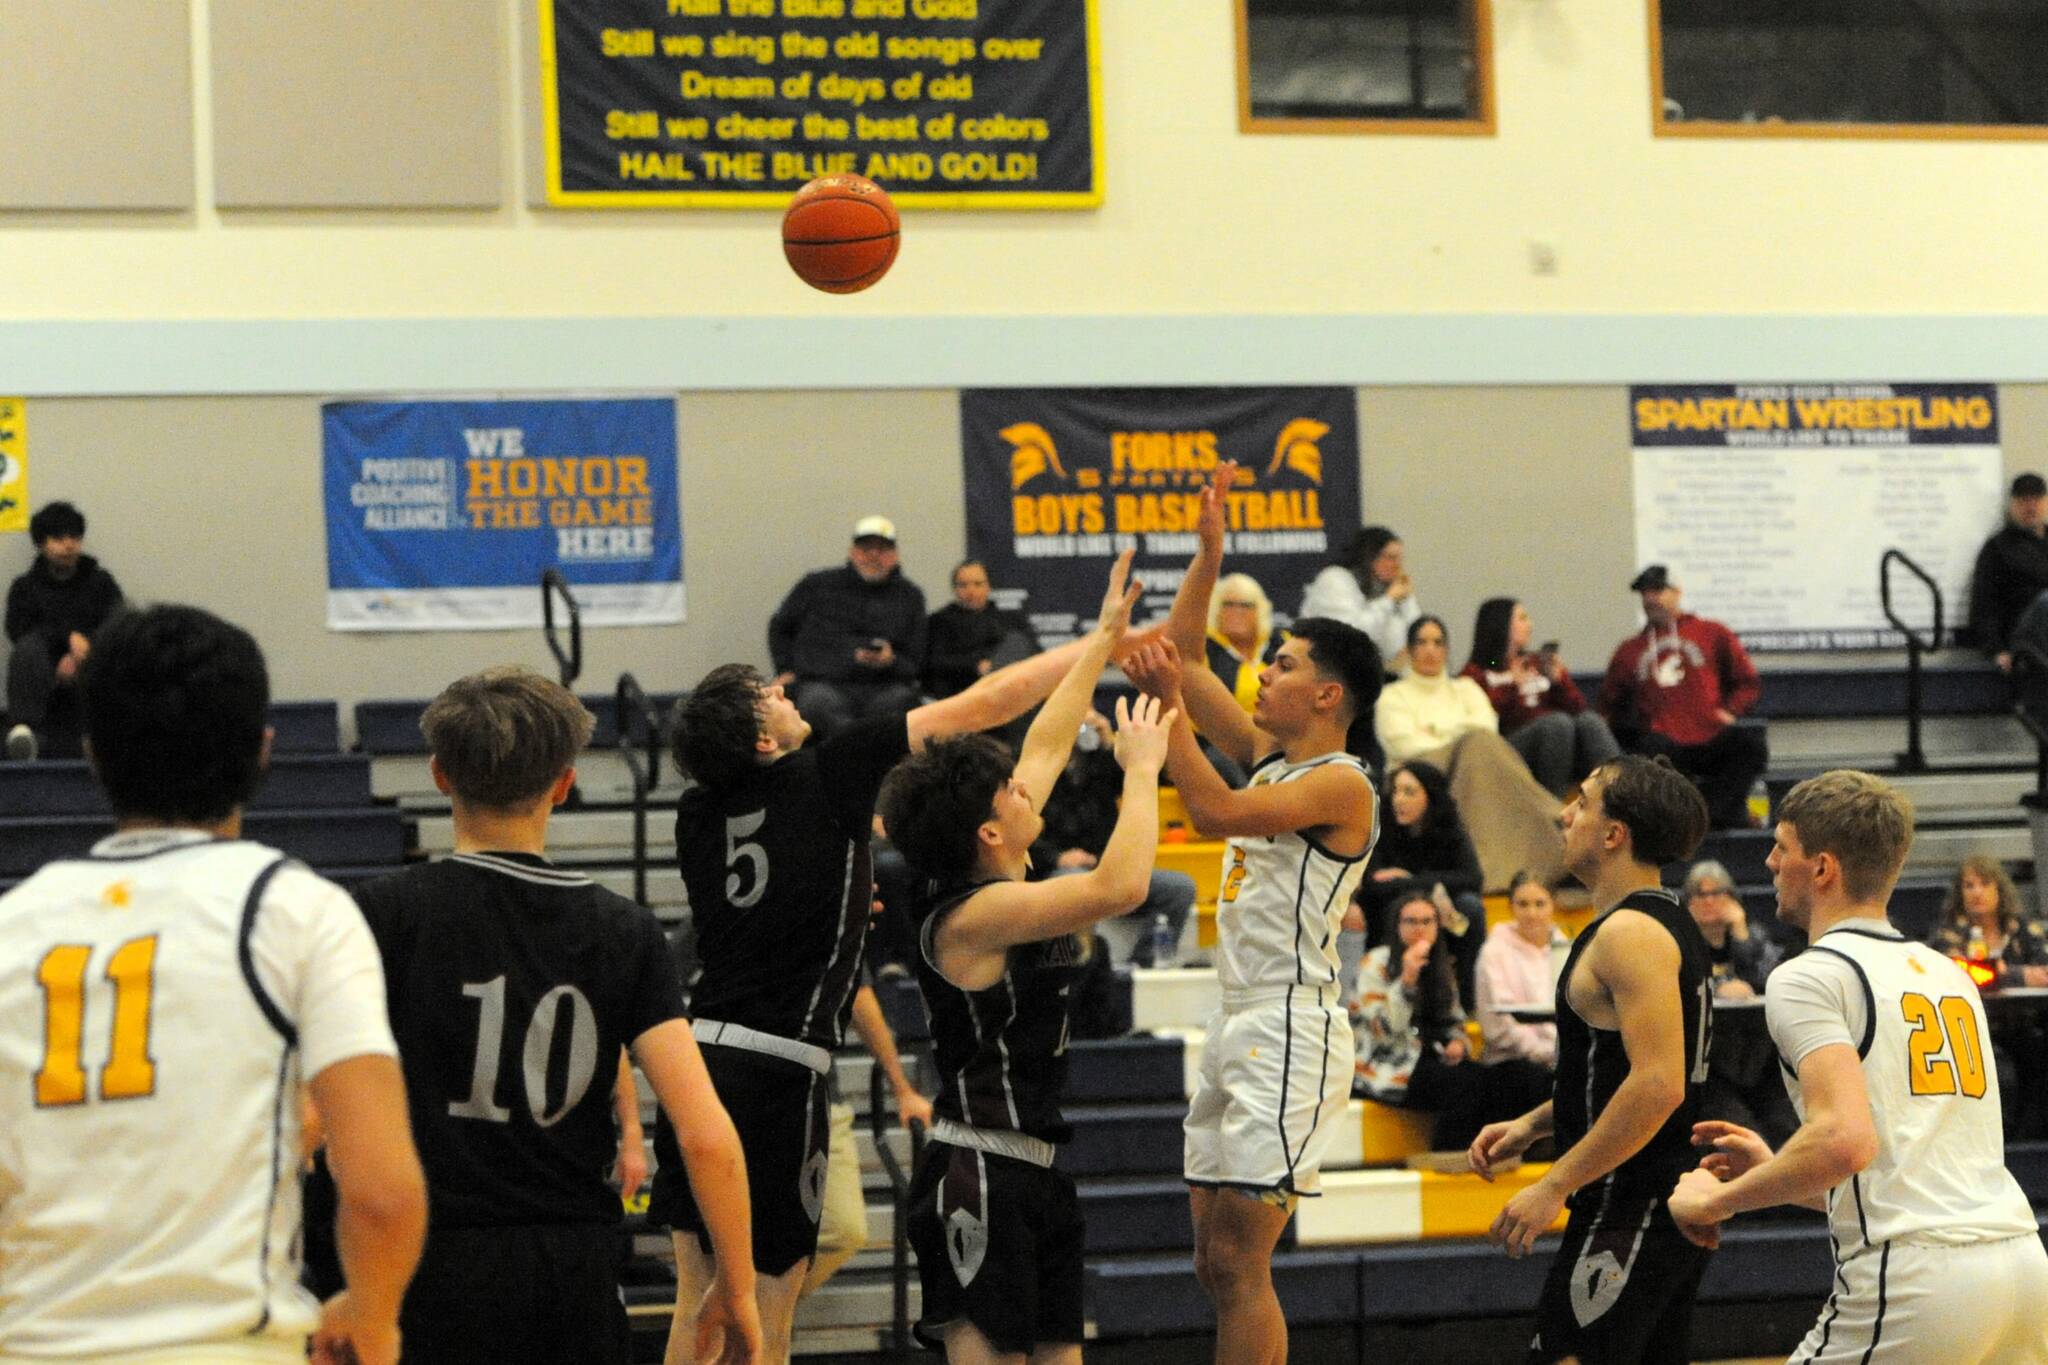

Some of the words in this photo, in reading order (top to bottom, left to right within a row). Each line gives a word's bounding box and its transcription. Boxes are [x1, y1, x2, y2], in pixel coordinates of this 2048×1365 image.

[602, 28, 654, 57] Still
[660, 36, 704, 57] we
[711, 31, 775, 64] sing
[780, 31, 828, 58] the
[834, 31, 879, 59] old
[886, 37, 976, 66] songs
[982, 38, 1044, 60] over
[680, 70, 775, 98] Dream
[781, 71, 812, 99] of
[817, 72, 885, 106] days
[891, 72, 923, 99] of
[928, 74, 973, 99] old
[606, 109, 659, 139] Still
[665, 117, 709, 139] we
[715, 111, 797, 139] cheer
[803, 113, 849, 140] the
[855, 112, 919, 140] best
[924, 112, 955, 140] of
[960, 113, 1049, 140] colors
[619, 152, 694, 181] HAIL
[700, 152, 765, 181] THE
[772, 152, 857, 181] BLUE
[865, 152, 933, 181] AND
[939, 152, 1038, 181] GOLD!
[1635, 398, 1789, 431] SPARTAN
[1796, 396, 1991, 430] WRESTLING
[463, 428, 525, 458] WE
[1111, 431, 1219, 472] FORKS
[465, 457, 651, 498] HONOR
[466, 501, 542, 529] THE
[550, 500, 653, 527] GAME
[1012, 493, 1105, 535] BOYS
[1115, 489, 1324, 533] BASKTBALL
[557, 527, 653, 556] HERE
[725, 808, 769, 907] 5
[34, 934, 159, 1108] 11
[447, 974, 598, 1128] 10
[1900, 992, 1987, 1099] 20
